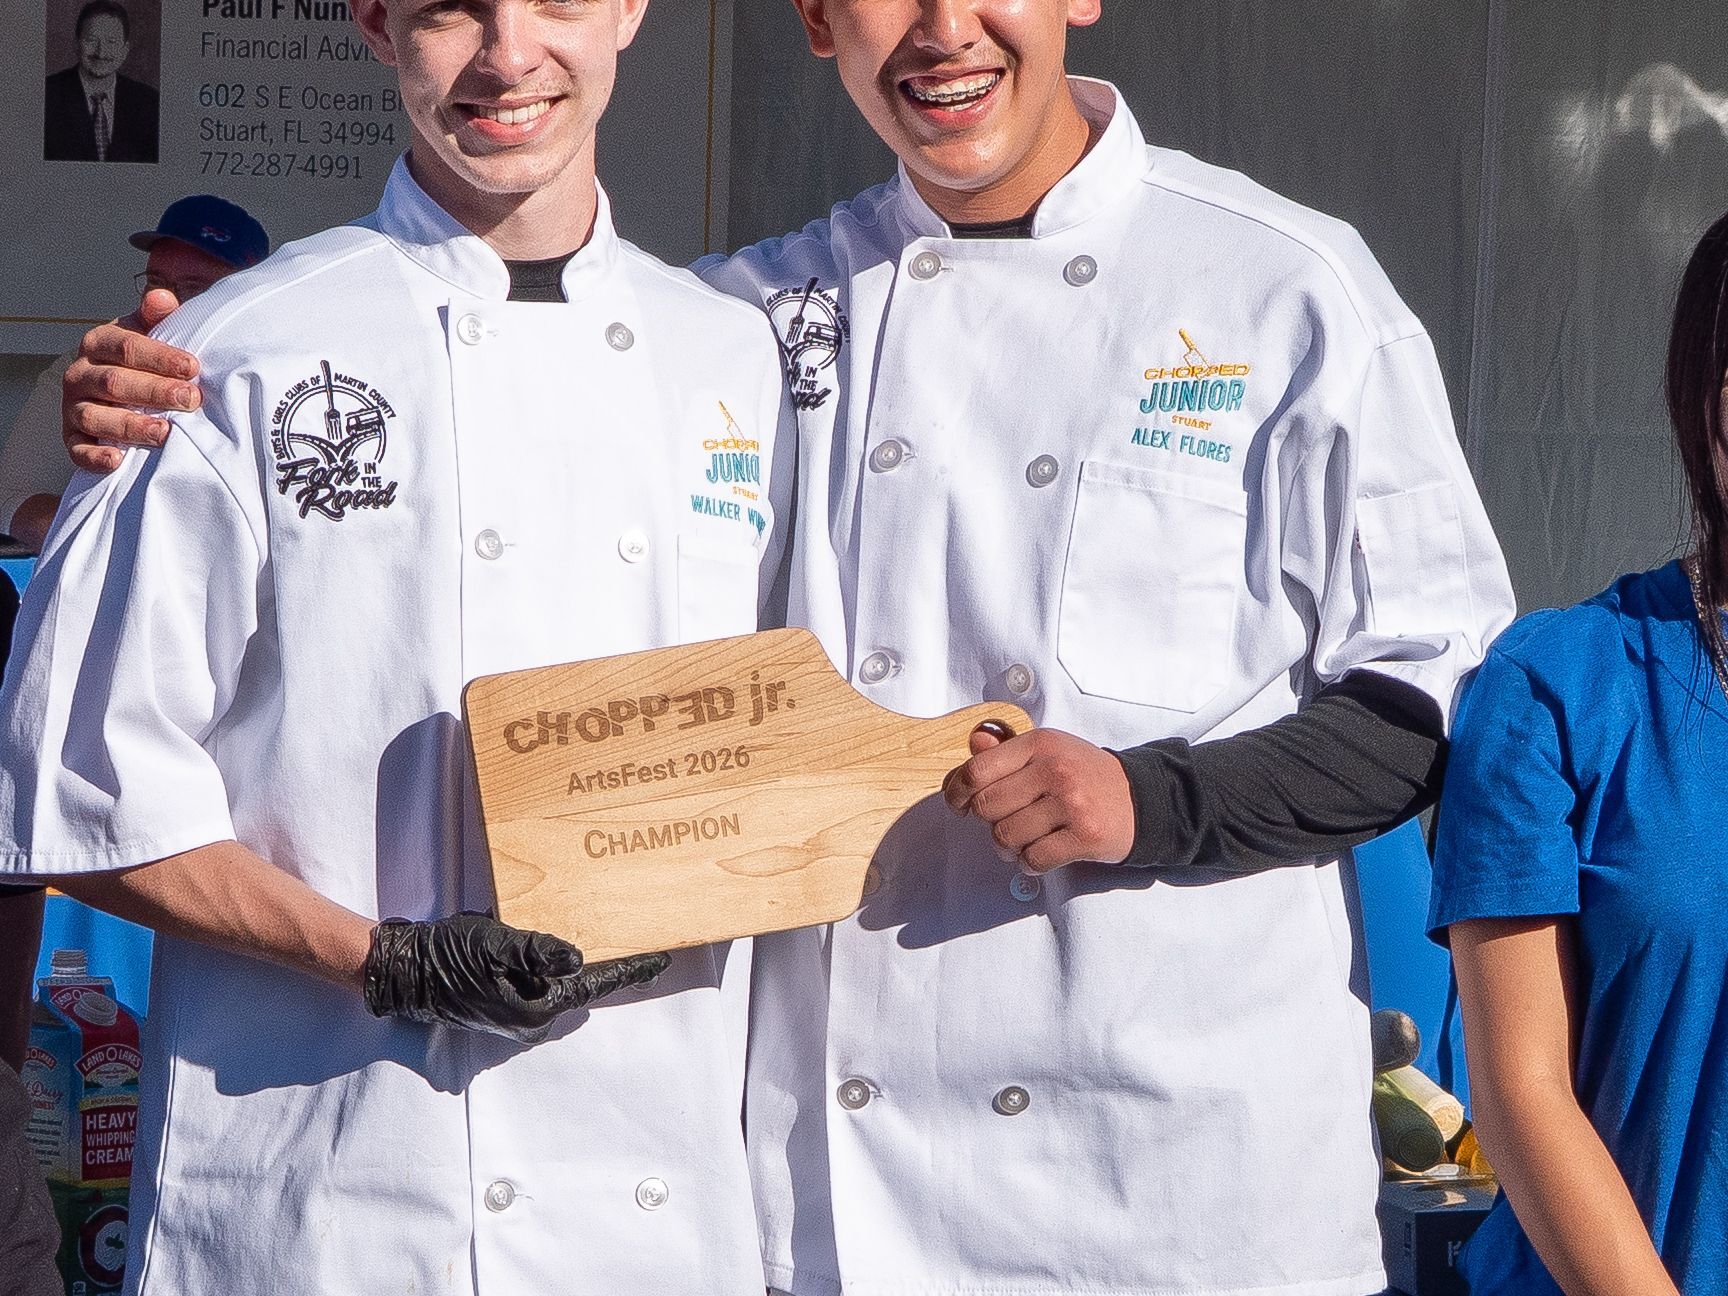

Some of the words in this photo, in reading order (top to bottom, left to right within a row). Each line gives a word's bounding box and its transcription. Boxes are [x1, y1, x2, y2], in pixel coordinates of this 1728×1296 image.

[200, 32, 308, 61] Financial
[317, 35, 379, 62] Advi
[198, 83, 246, 109] 602
[255, 85, 270, 109] S
[278, 86, 293, 110] E
[301, 86, 373, 112] Ocean
[199, 117, 273, 148] Stuart,
[283, 119, 310, 144] FL
[320, 121, 396, 146] 34994
[200, 152, 363, 180] 772-287-4991
[799, 378, 819, 393] THE
[805, 365, 818, 379] IN
[1144, 363, 1250, 381] CHOPPED
[284, 380, 310, 400] CLUBS
[310, 374, 321, 385] OF
[334, 372, 368, 392] MARTIN
[368, 388, 397, 419] COUNTY
[1139, 379, 1247, 414] JUNIOR
[1172, 415, 1213, 431] STUART
[1131, 427, 1173, 451] ALEX
[1179, 434, 1233, 463] FLORES
[275, 457, 361, 495] Fork
[361, 476, 383, 489] THE
[364, 462, 377, 475] IN
[295, 480, 398, 522] Road
[690, 494, 741, 522] WALKER
[748, 669, 796, 727] jr.
[567, 758, 678, 796] ArtsFest
[683, 745, 751, 777] 2026
[584, 812, 741, 859] CHAMPION
[82, 1051, 105, 1072] LAND
[118, 1049, 141, 1068] LAKES
[86, 1111, 136, 1131] HEAVY
[86, 1130, 135, 1147] WHIPPING
